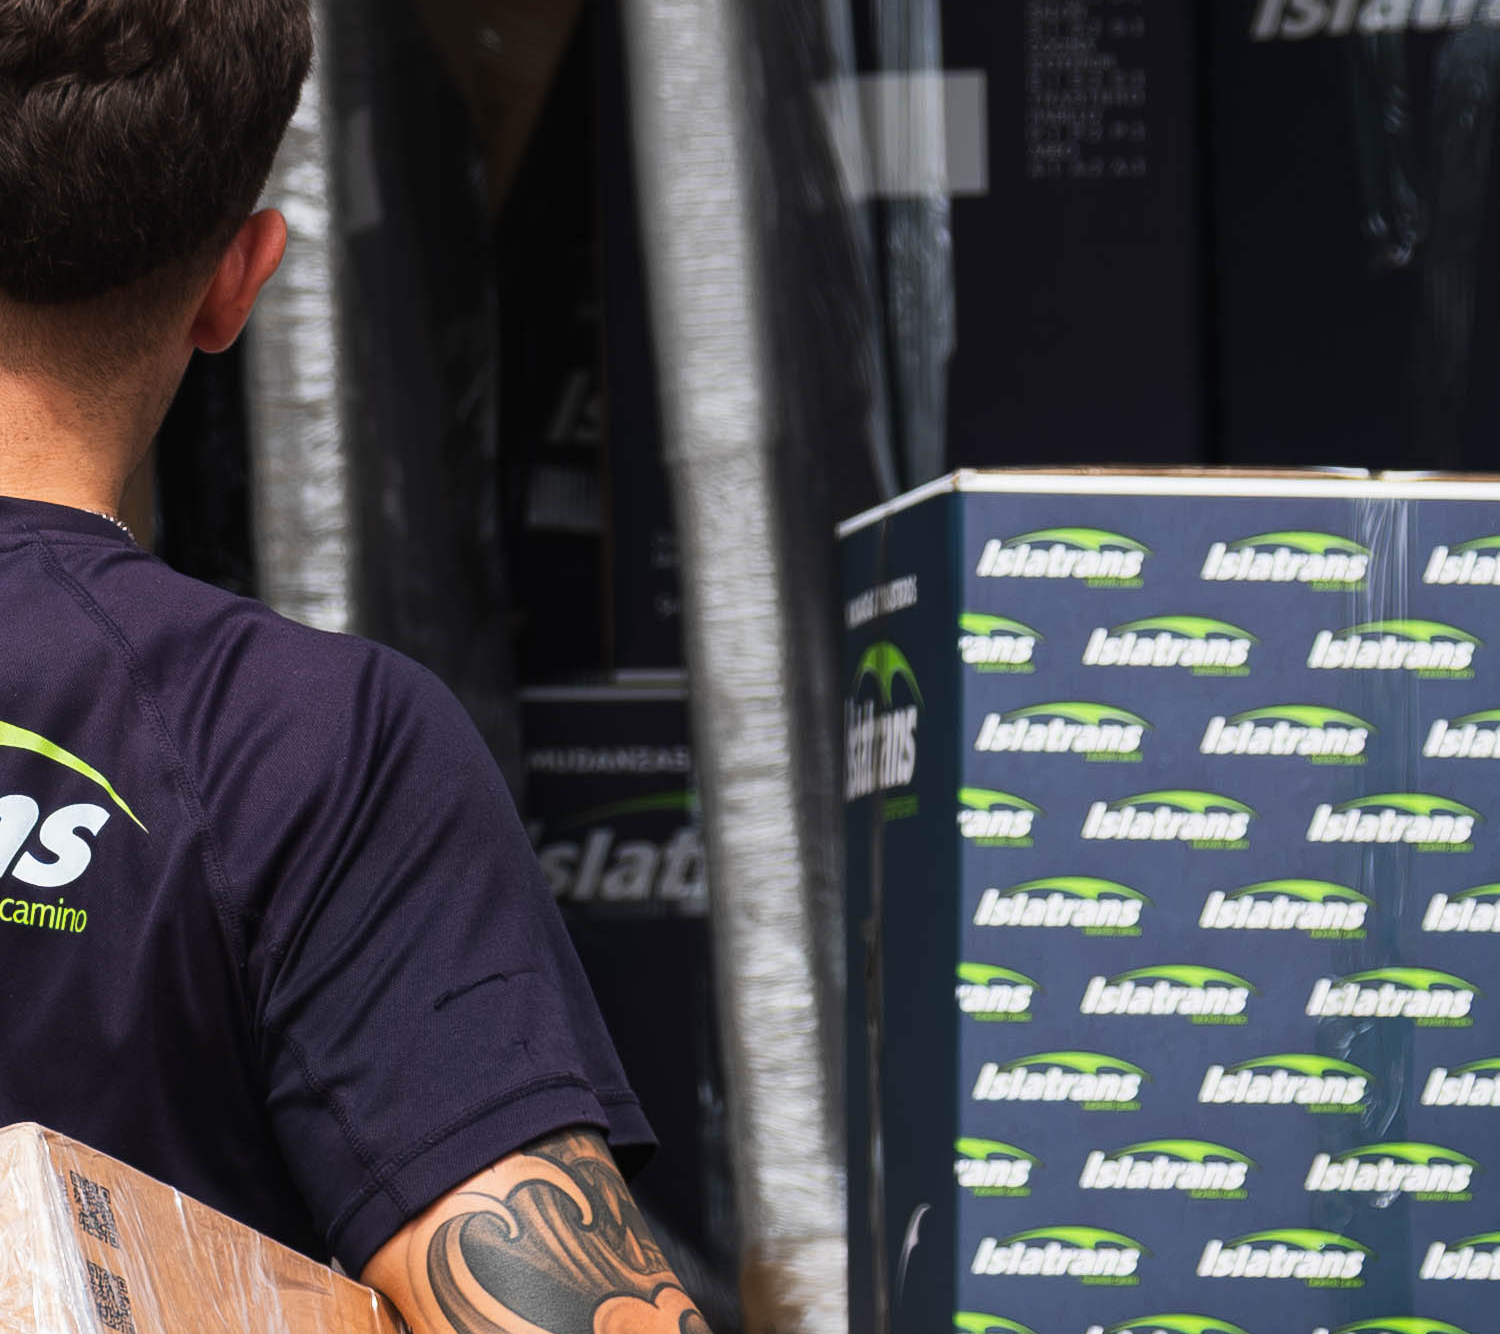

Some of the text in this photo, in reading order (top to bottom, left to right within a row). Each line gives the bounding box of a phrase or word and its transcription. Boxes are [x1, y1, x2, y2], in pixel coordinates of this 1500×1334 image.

[974, 537, 1147, 580] Islatrans
[1200, 540, 1371, 584] Islatrans
[1081, 626, 1253, 669] Islatrans
[1306, 628, 1477, 672] Islatrans
[973, 711, 1146, 755] Islatrans
[1199, 714, 1370, 758] Islatrans
[1080, 800, 1252, 843] Islatrans
[1305, 802, 1476, 845] Islatrans
[972, 886, 1145, 929] Islatrans
[1197, 889, 1369, 932] Islatrans
[1079, 974, 1251, 1017] Islatrans
[1304, 977, 1476, 1020] Islatrans
[971, 1061, 1143, 1104] Islatrans
[1197, 1063, 1369, 1106] Islatrans
[1078, 1149, 1250, 1192] Islatrans
[1304, 1152, 1475, 1195] Islatrans
[969, 1235, 1142, 1278] Islatrans
[1195, 1238, 1367, 1281] Islatrans
